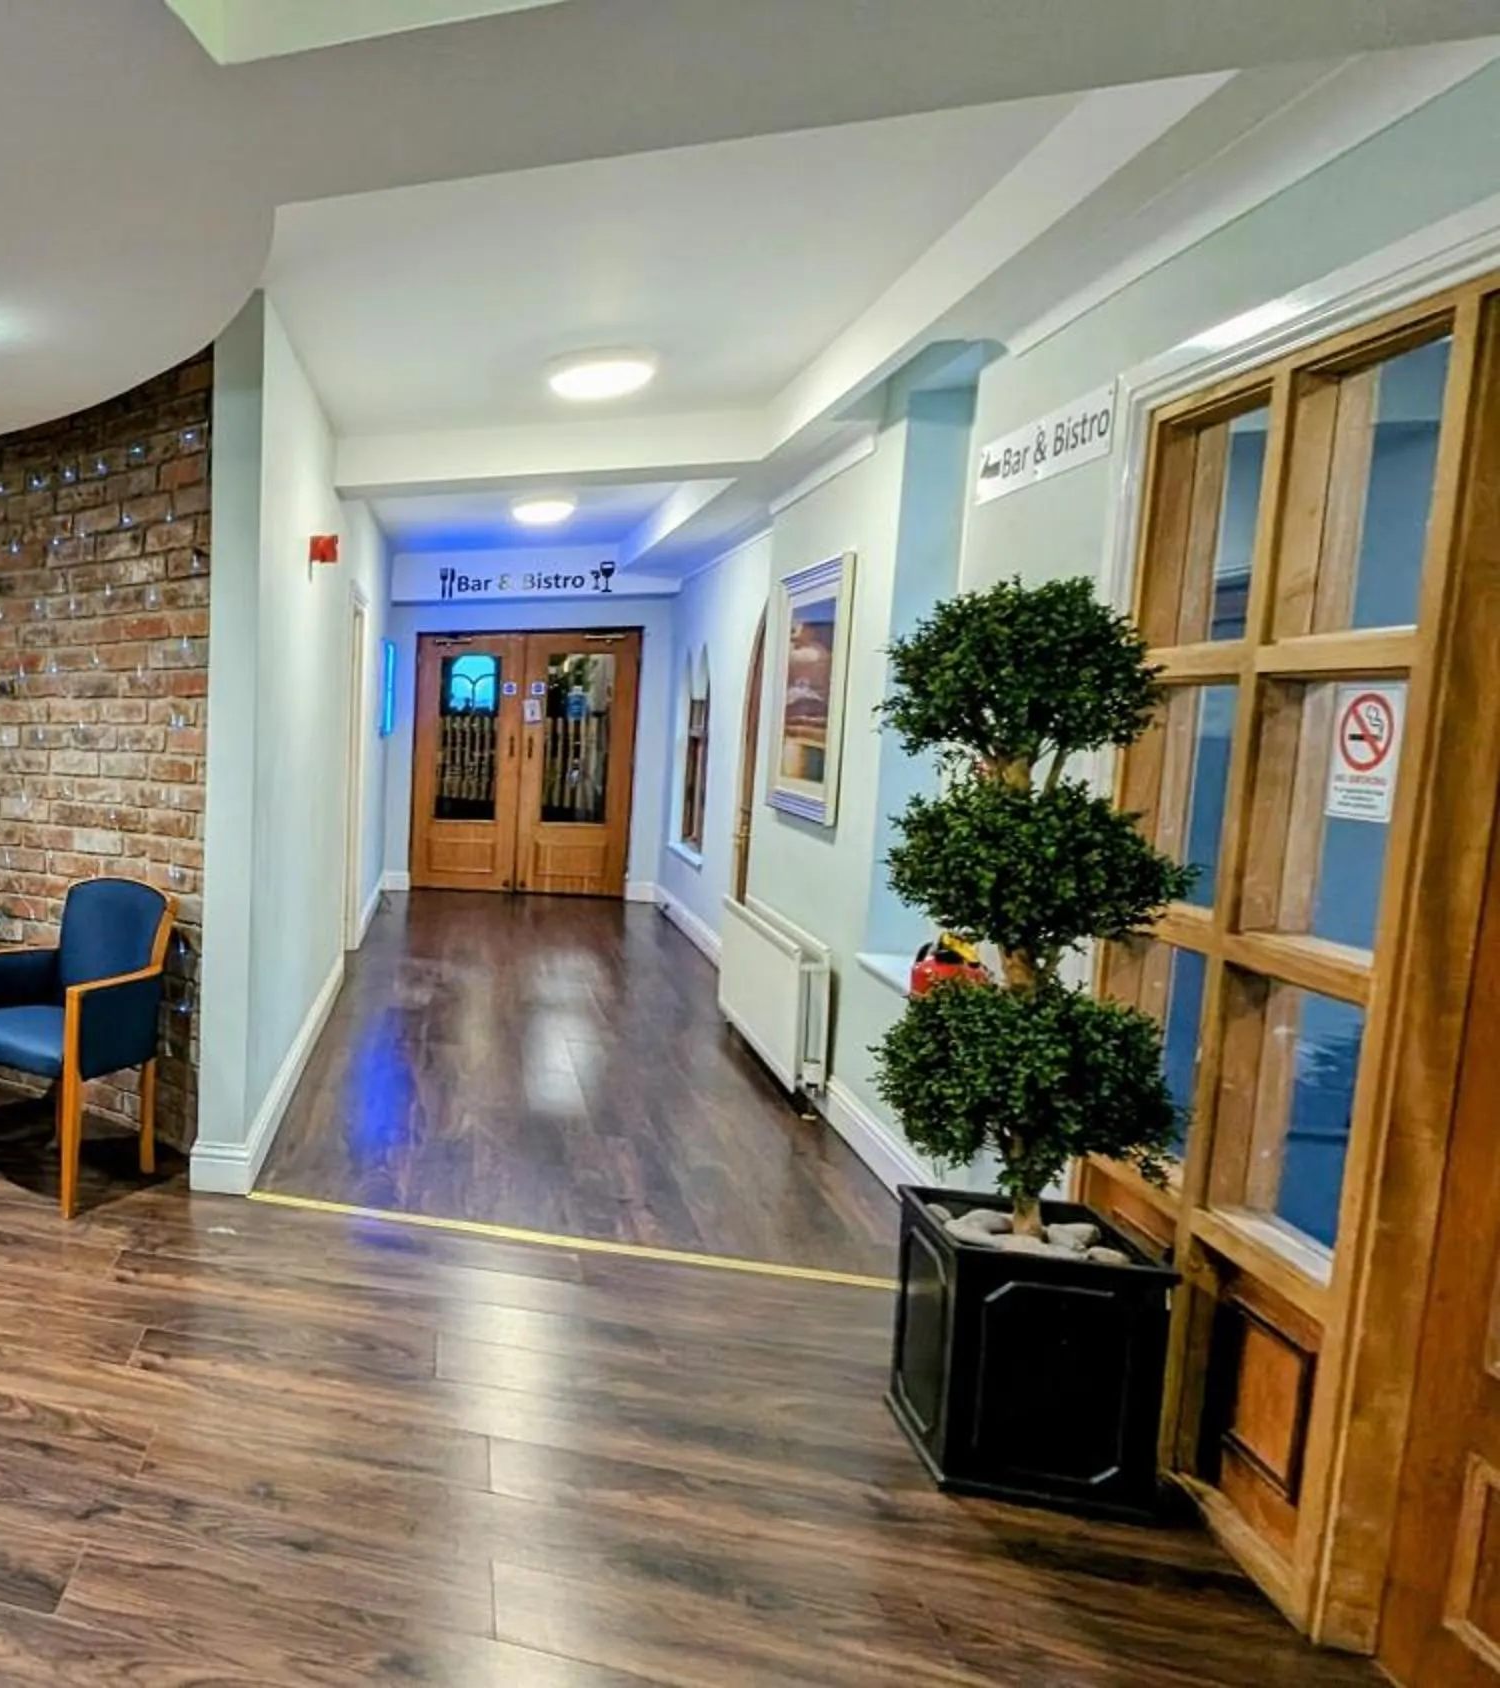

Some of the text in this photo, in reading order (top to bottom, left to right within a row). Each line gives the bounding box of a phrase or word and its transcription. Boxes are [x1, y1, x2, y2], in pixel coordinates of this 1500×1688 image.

[1002, 409, 1110, 478] Bar & Bistro
[457, 575, 492, 592] Bar
[522, 569, 585, 589] Bistro
